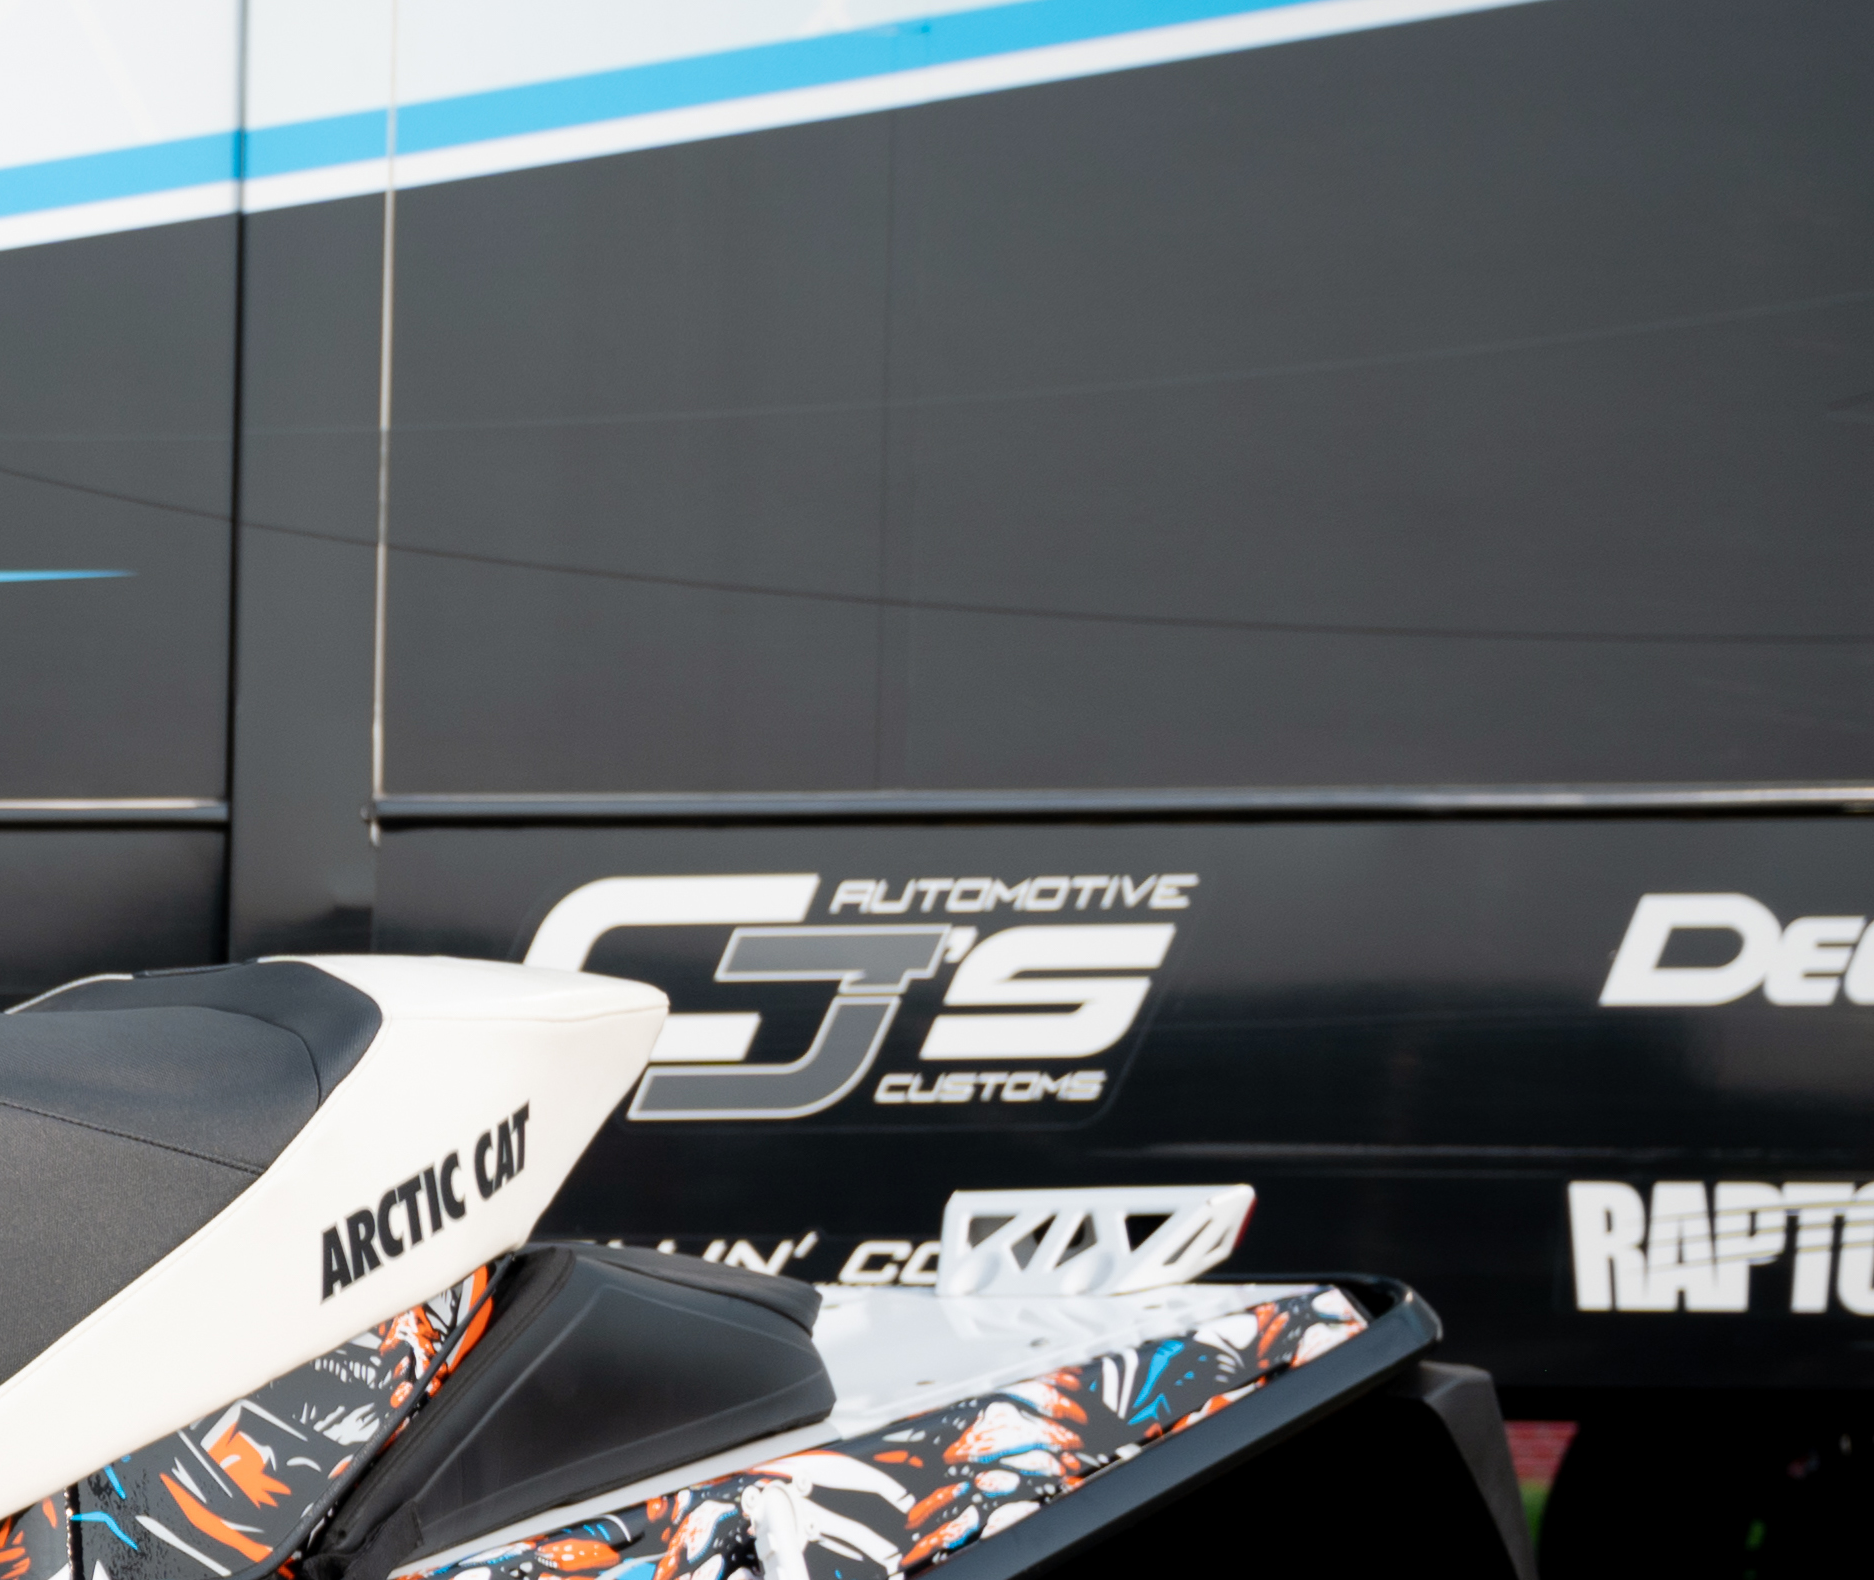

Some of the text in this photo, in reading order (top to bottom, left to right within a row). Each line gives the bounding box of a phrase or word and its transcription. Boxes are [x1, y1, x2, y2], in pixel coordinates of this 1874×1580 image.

[829, 874, 1198, 914] AUTOMOTIVE
[874, 1070, 1107, 1103] CUSTOMS
[320, 1099, 530, 1305] ARCTIC CAT
